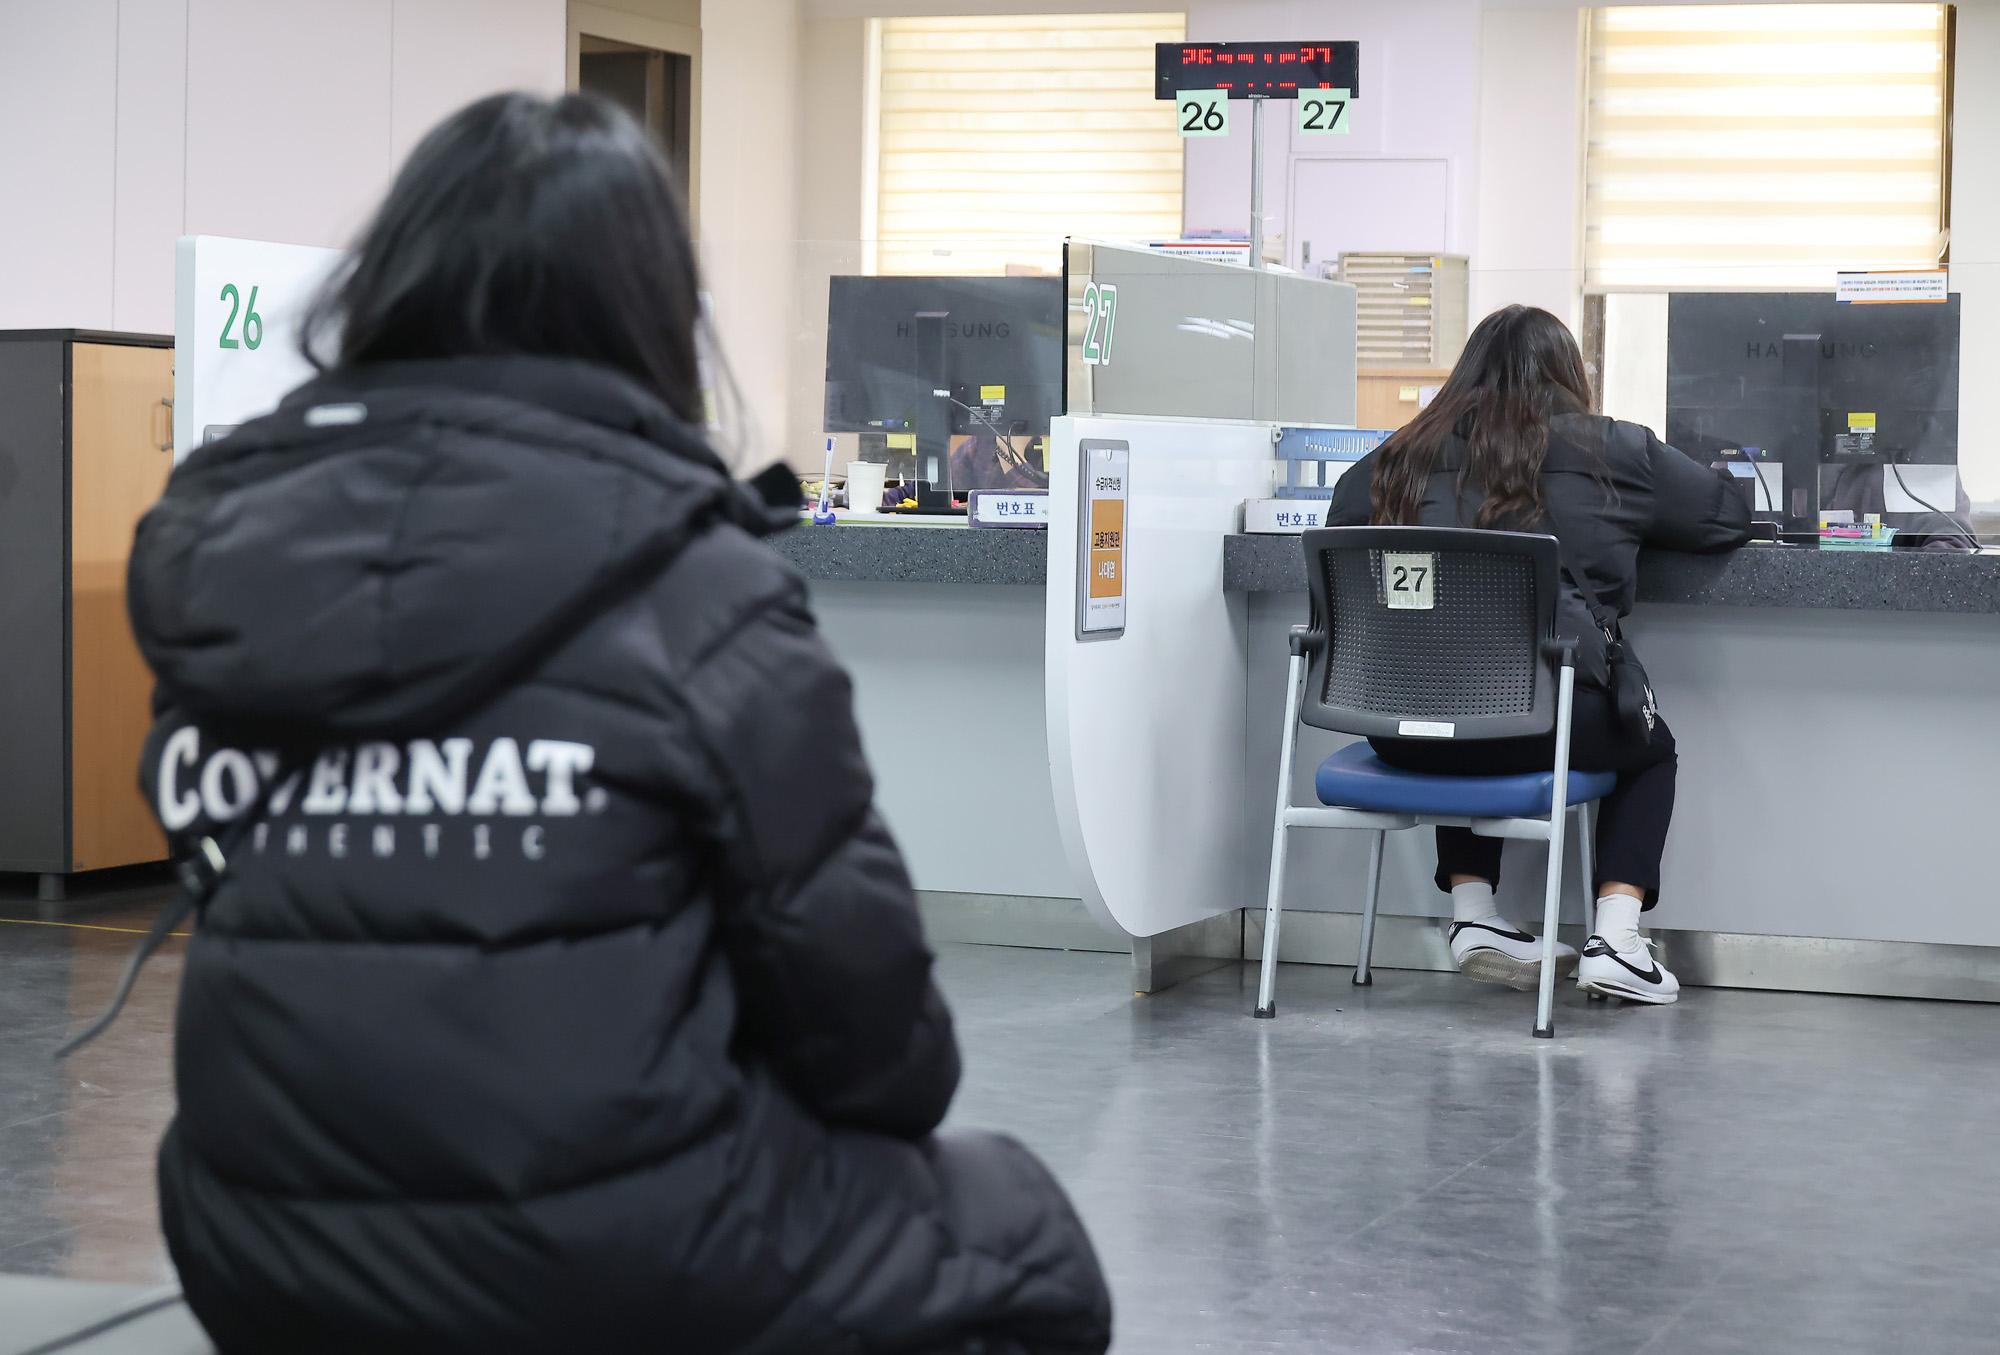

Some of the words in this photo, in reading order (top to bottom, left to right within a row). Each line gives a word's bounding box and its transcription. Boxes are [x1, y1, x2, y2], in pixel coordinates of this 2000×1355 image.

[1182, 101, 1224, 131] 26
[1303, 99, 1345, 130] 27
[219, 283, 263, 350] 26
[897, 322, 1010, 338] HSUNG
[1083, 282, 1117, 365] 27
[1746, 341, 1876, 360] HAUNG
[996, 502, 1036, 516] 번호표
[1276, 512, 1318, 527] 번호표
[1393, 565, 1428, 592] 27
